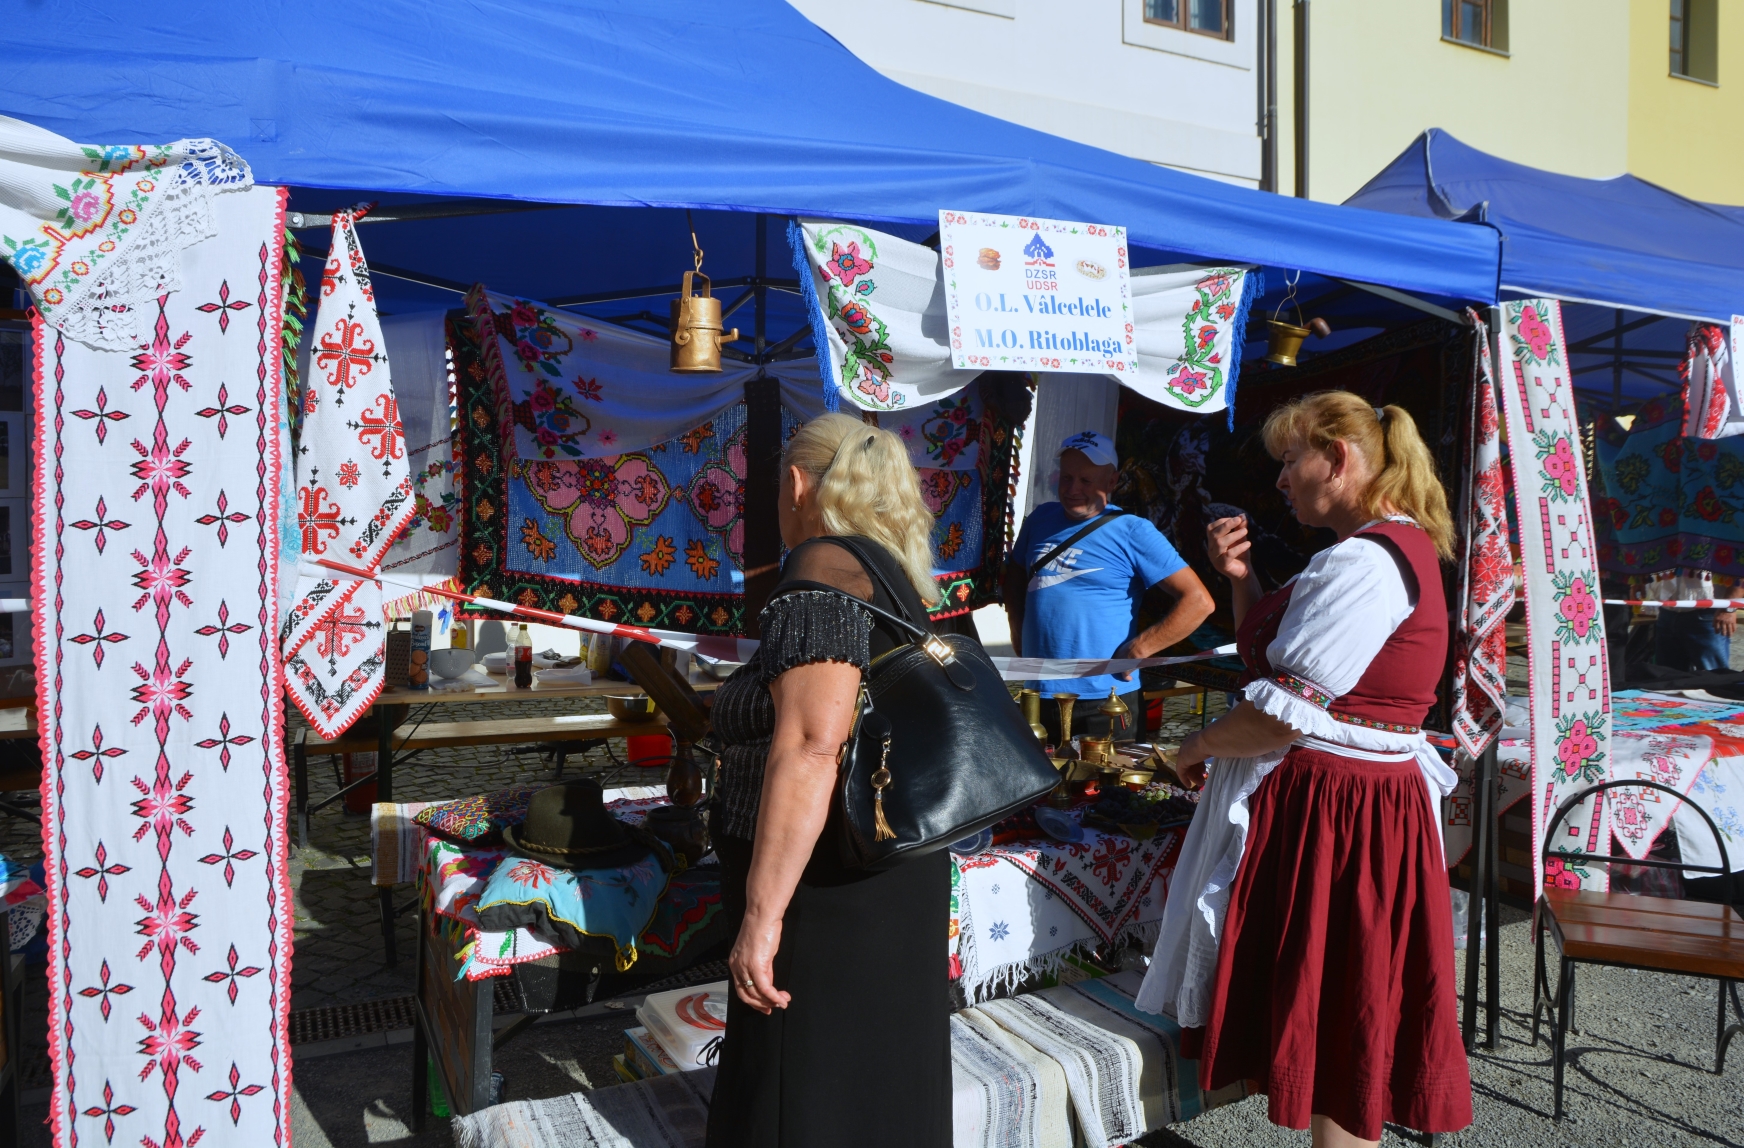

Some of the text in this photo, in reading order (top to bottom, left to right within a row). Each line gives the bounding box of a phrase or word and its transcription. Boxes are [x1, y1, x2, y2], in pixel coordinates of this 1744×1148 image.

[1025, 268, 1057, 280] DZSR
[1026, 280, 1058, 291] UDSR
[974, 292, 1112, 319] O.L. Vâlcelele
[974, 328, 1123, 359] M.O. Ritoblaga
[1071, 437, 1099, 448] adidas
